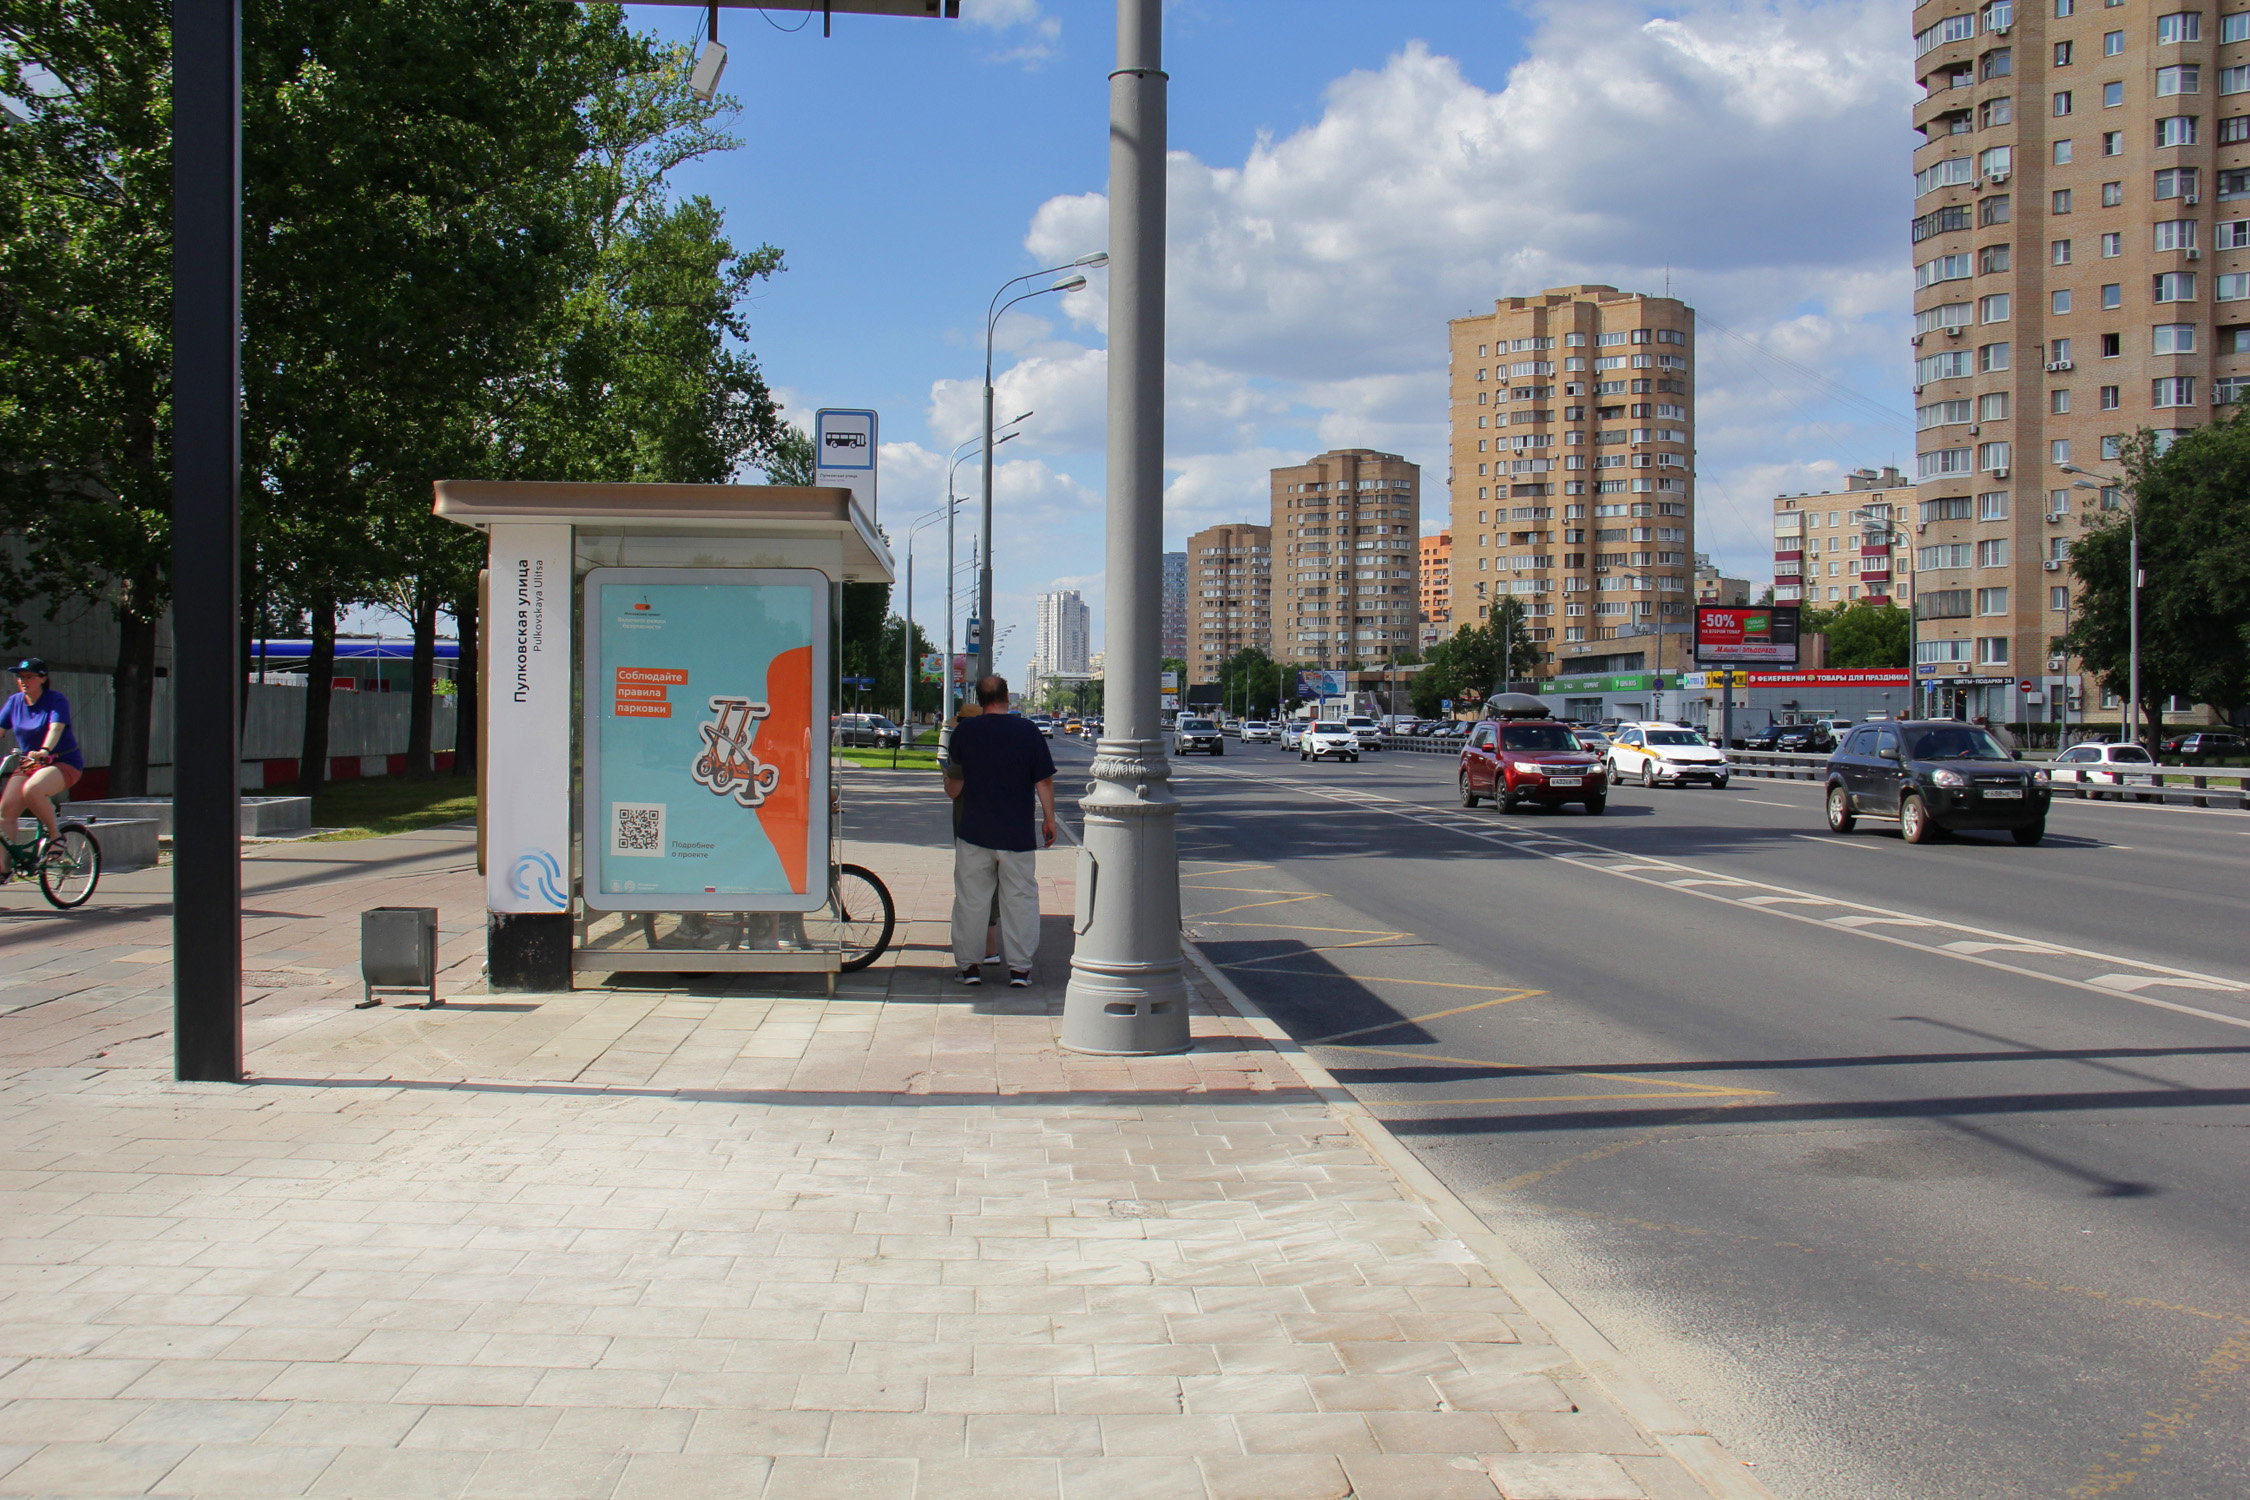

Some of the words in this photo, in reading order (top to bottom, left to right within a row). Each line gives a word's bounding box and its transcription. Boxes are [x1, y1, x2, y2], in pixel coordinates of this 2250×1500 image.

[533, 560, 543, 588] Ulitsa
[518, 560, 530, 606] улица
[533, 591, 544, 652] Pulkovskaya
[1701, 614, 1735, 628] -50%
[514, 610, 529, 702] Пулковская
[618, 670, 683, 682] Соблюдайте
[1817, 674, 1847, 682] ТОВАРЫ
[1848, 674, 1864, 682] ДЛЯ
[1865, 673, 1909, 682] ПРАЗДНИКА
[618, 688, 661, 697] правила
[617, 704, 666, 714] парковки
[671, 840, 715, 850] Подробнее
[678, 851, 709, 860] проекте
